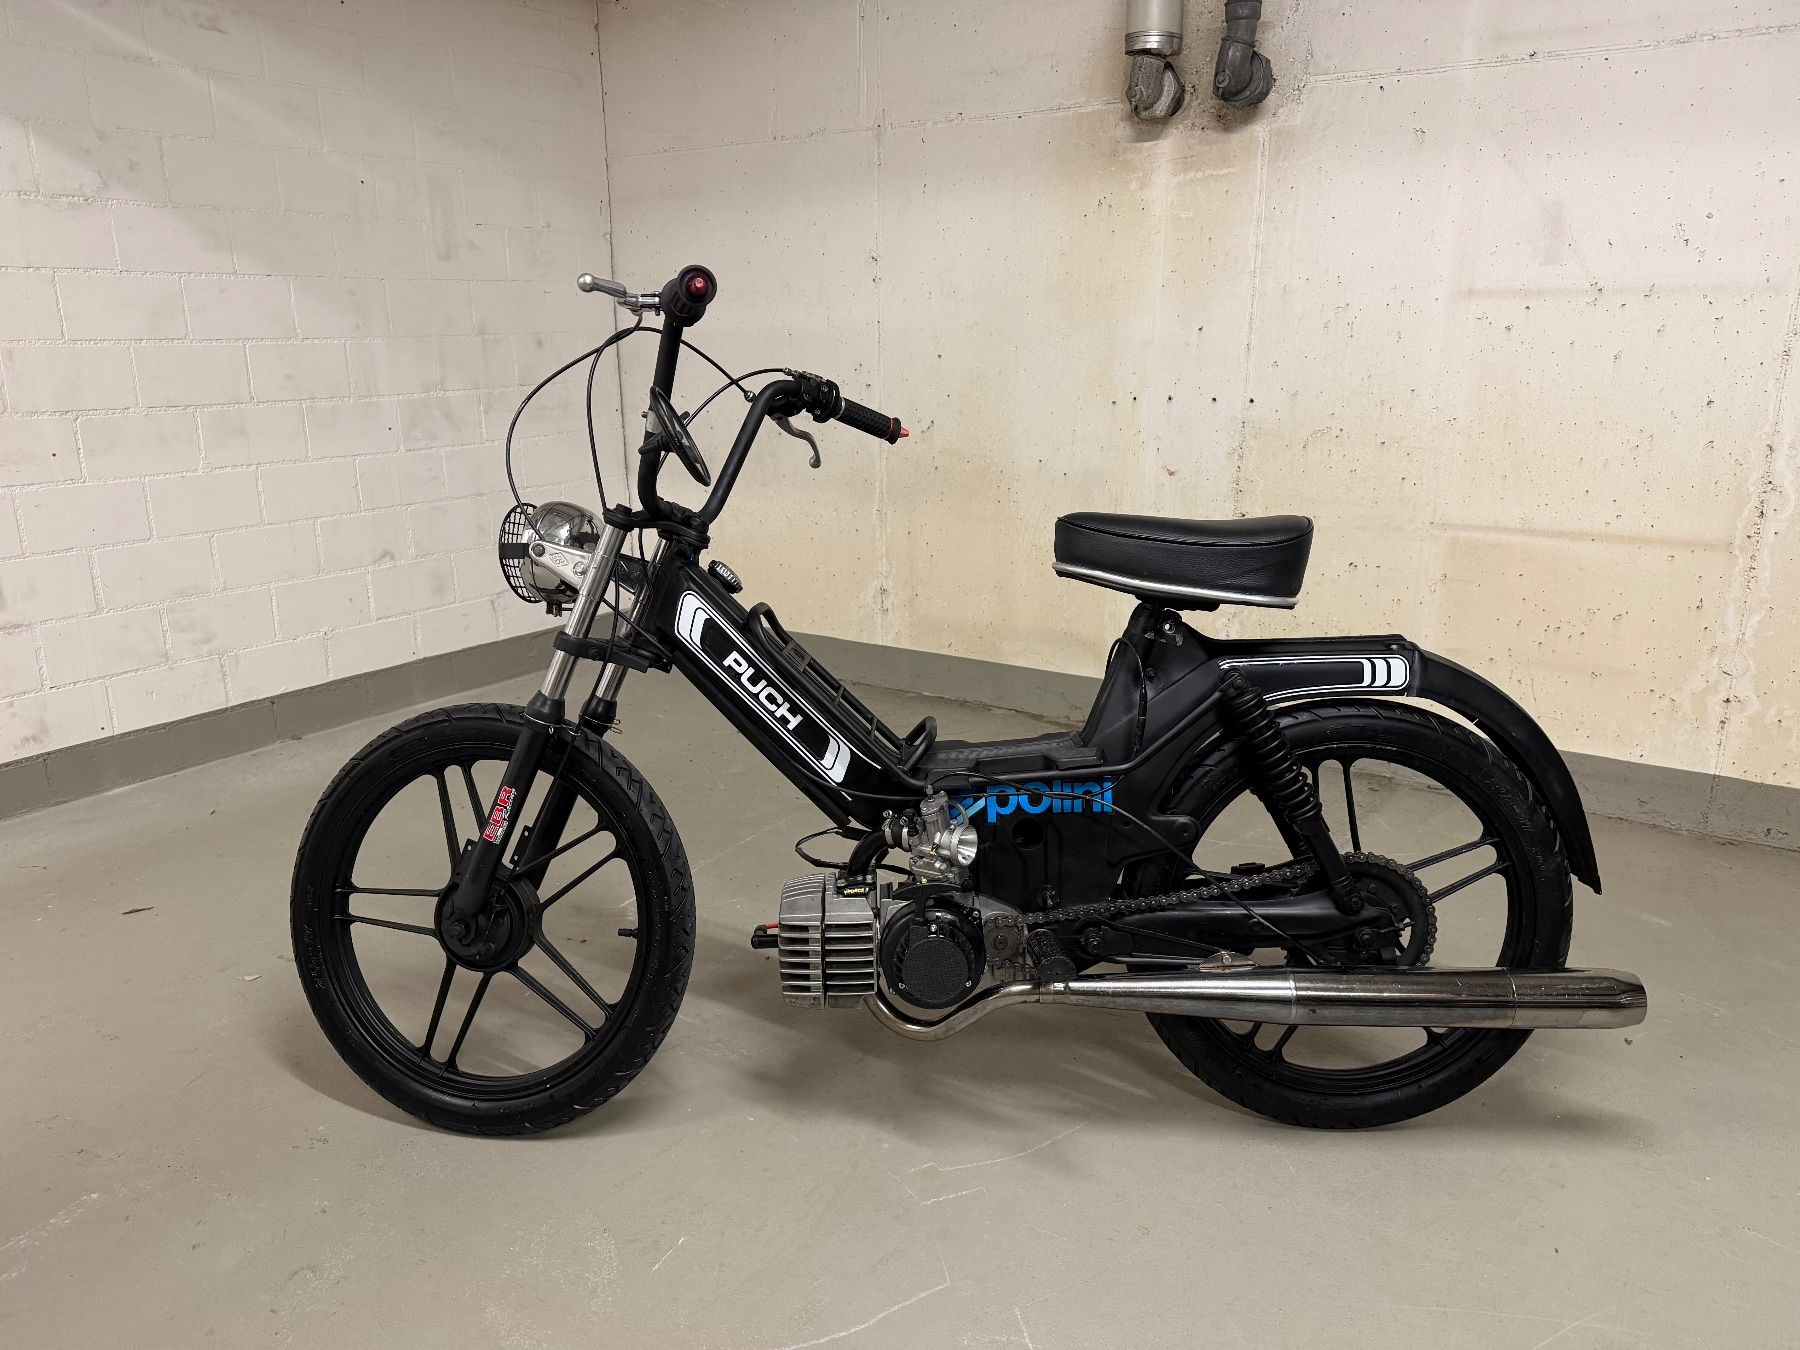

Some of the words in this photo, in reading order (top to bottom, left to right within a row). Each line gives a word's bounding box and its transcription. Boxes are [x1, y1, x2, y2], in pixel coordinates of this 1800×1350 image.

[722, 650, 803, 731] PUCH
[483, 786, 512, 841] EBR
[986, 779, 1113, 823] polini
